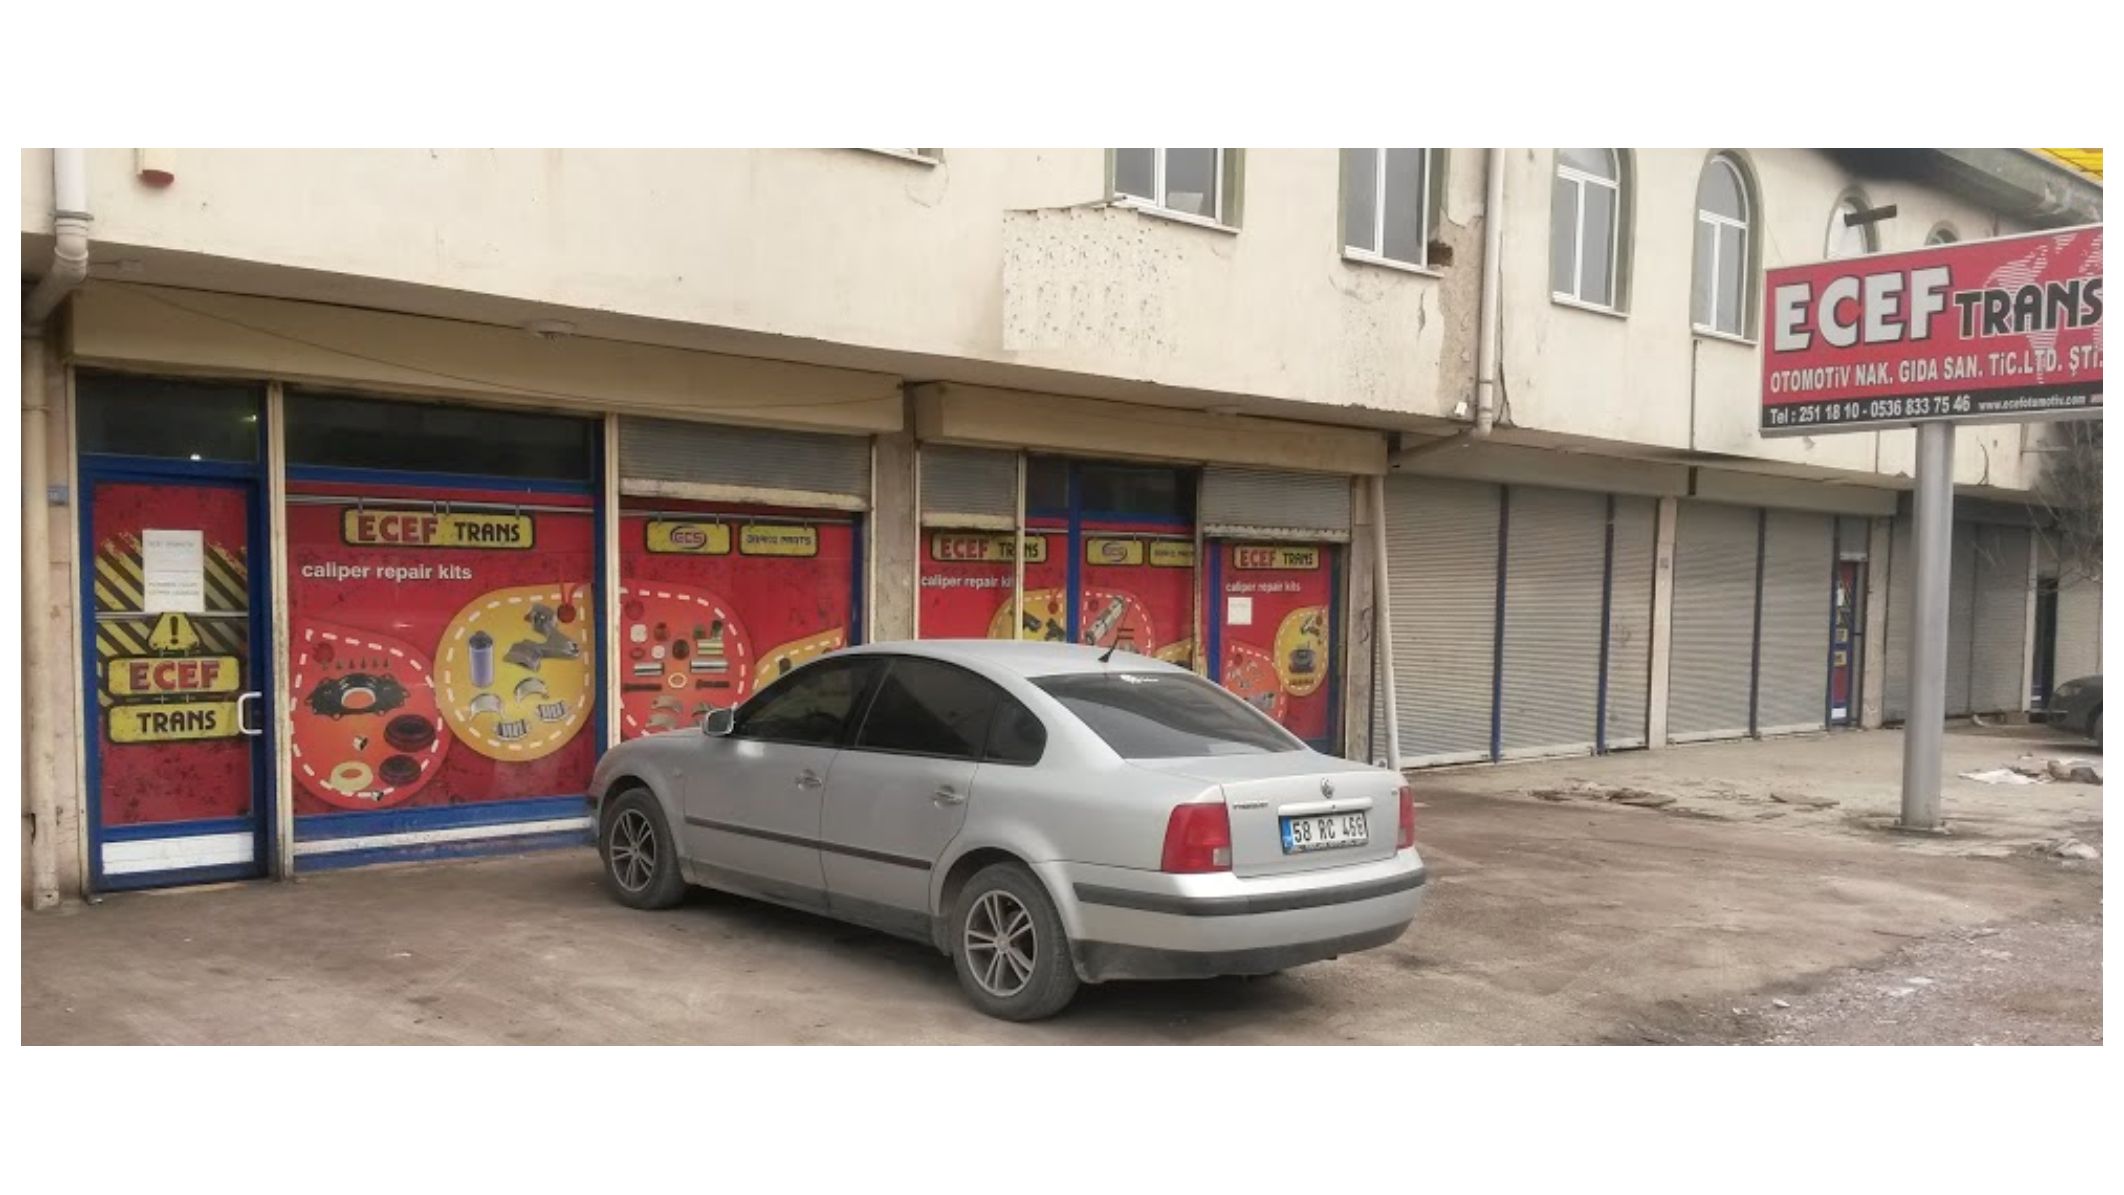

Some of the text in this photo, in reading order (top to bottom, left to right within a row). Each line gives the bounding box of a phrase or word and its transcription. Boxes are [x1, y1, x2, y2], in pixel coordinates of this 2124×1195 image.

[1774, 263, 2103, 353] ECEF TRANS
[1855, 362, 1893, 386] NAK.
[1899, 358, 1938, 382] GIDA
[1943, 354, 1983, 380] SAN.
[1800, 405, 1820, 422] 251
[1825, 404, 1840, 420] 18
[1844, 402, 1859, 419] 10
[1871, 401, 1900, 417] 0536
[1906, 398, 1929, 415] 833
[1934, 396, 1949, 413] 75
[1953, 394, 1970, 412] 46
[357, 515, 521, 543] ECEF TRANS
[941, 538, 1038, 558] ECEF TRNS
[1240, 549, 1313, 567] ECEF TRANS
[301, 562, 472, 583] caliper repair kits
[921, 574, 961, 589] caliper
[965, 576, 998, 590] repair
[1225, 580, 1256, 593] caliper
[1258, 581, 1283, 593] repair
[129, 660, 220, 690] ECEF
[136, 710, 217, 734] TRANS
[1293, 820, 1311, 843] 58
[1318, 818, 1336, 840] RC
